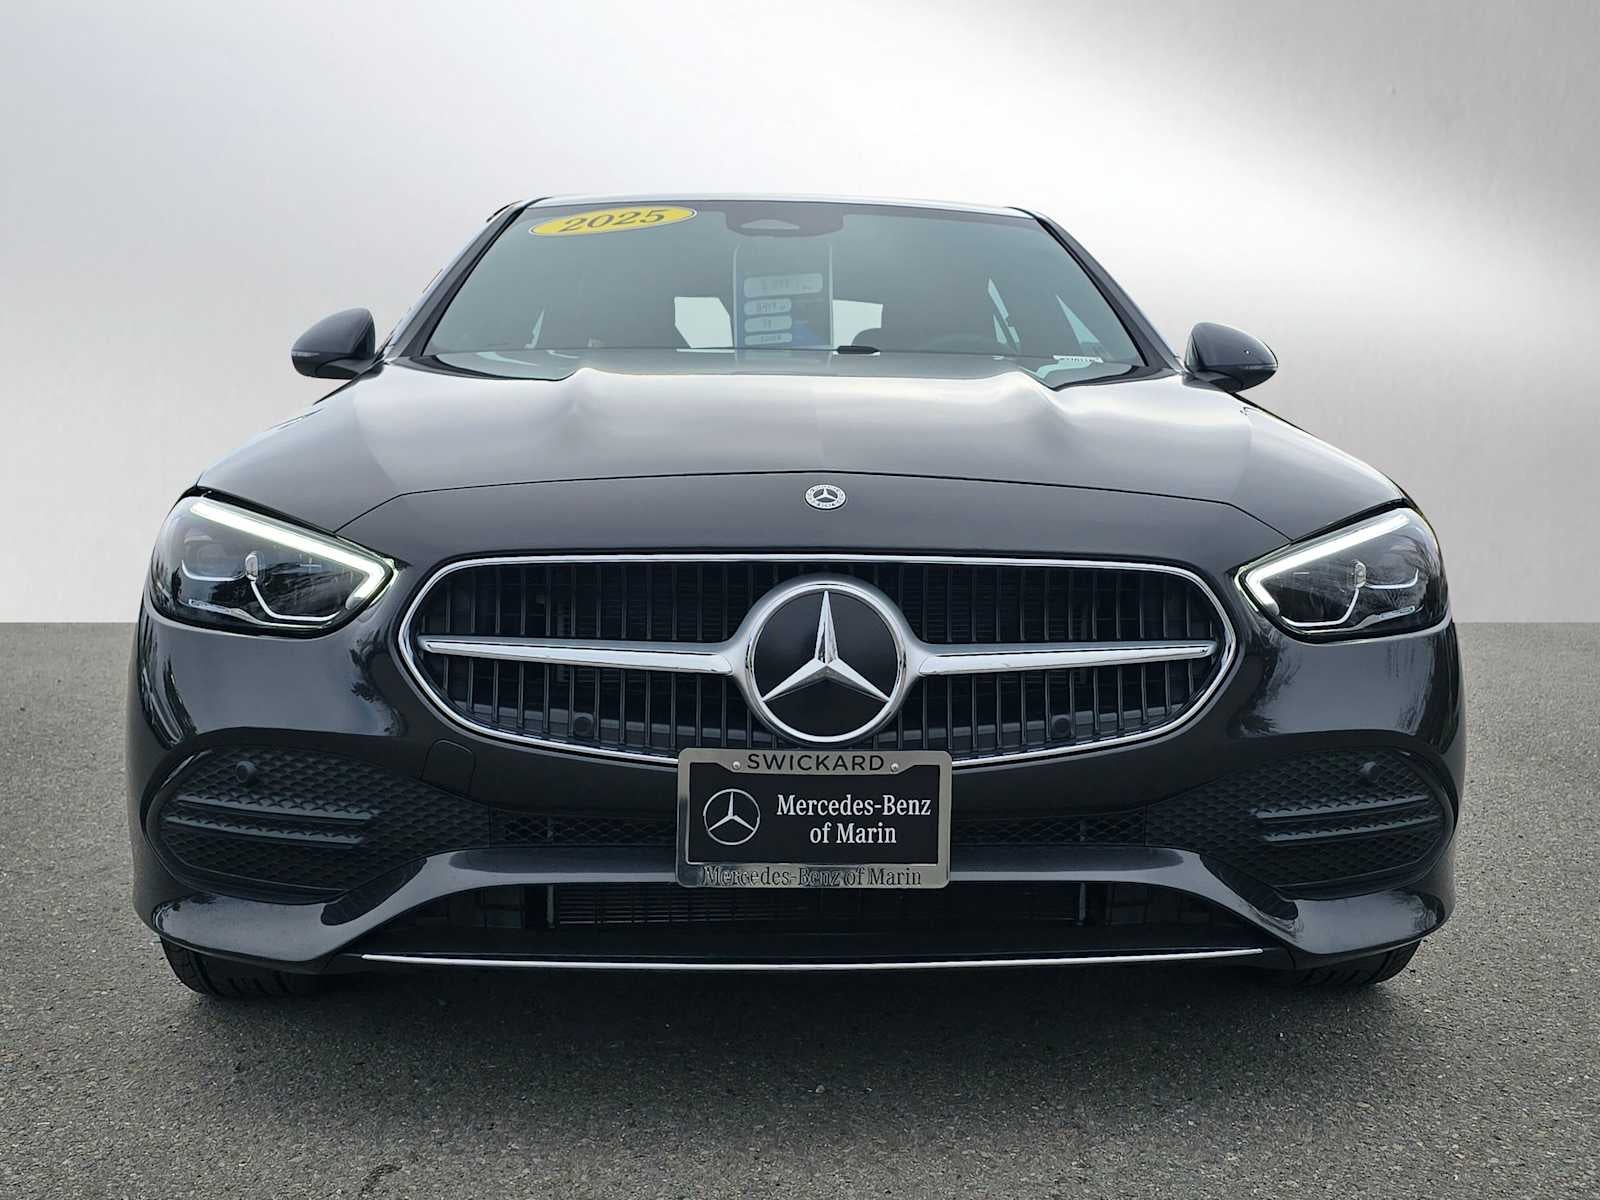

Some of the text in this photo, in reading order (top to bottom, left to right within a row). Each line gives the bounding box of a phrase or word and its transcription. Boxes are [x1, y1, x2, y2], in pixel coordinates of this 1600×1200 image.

[559, 209, 667, 232] 2025
[747, 753, 884, 771] SWICKARD
[776, 794, 931, 816] Mercedes-Benz
[810, 822, 897, 843] of Marin
[703, 865, 922, 887] Mercedes-Benz of Marin
